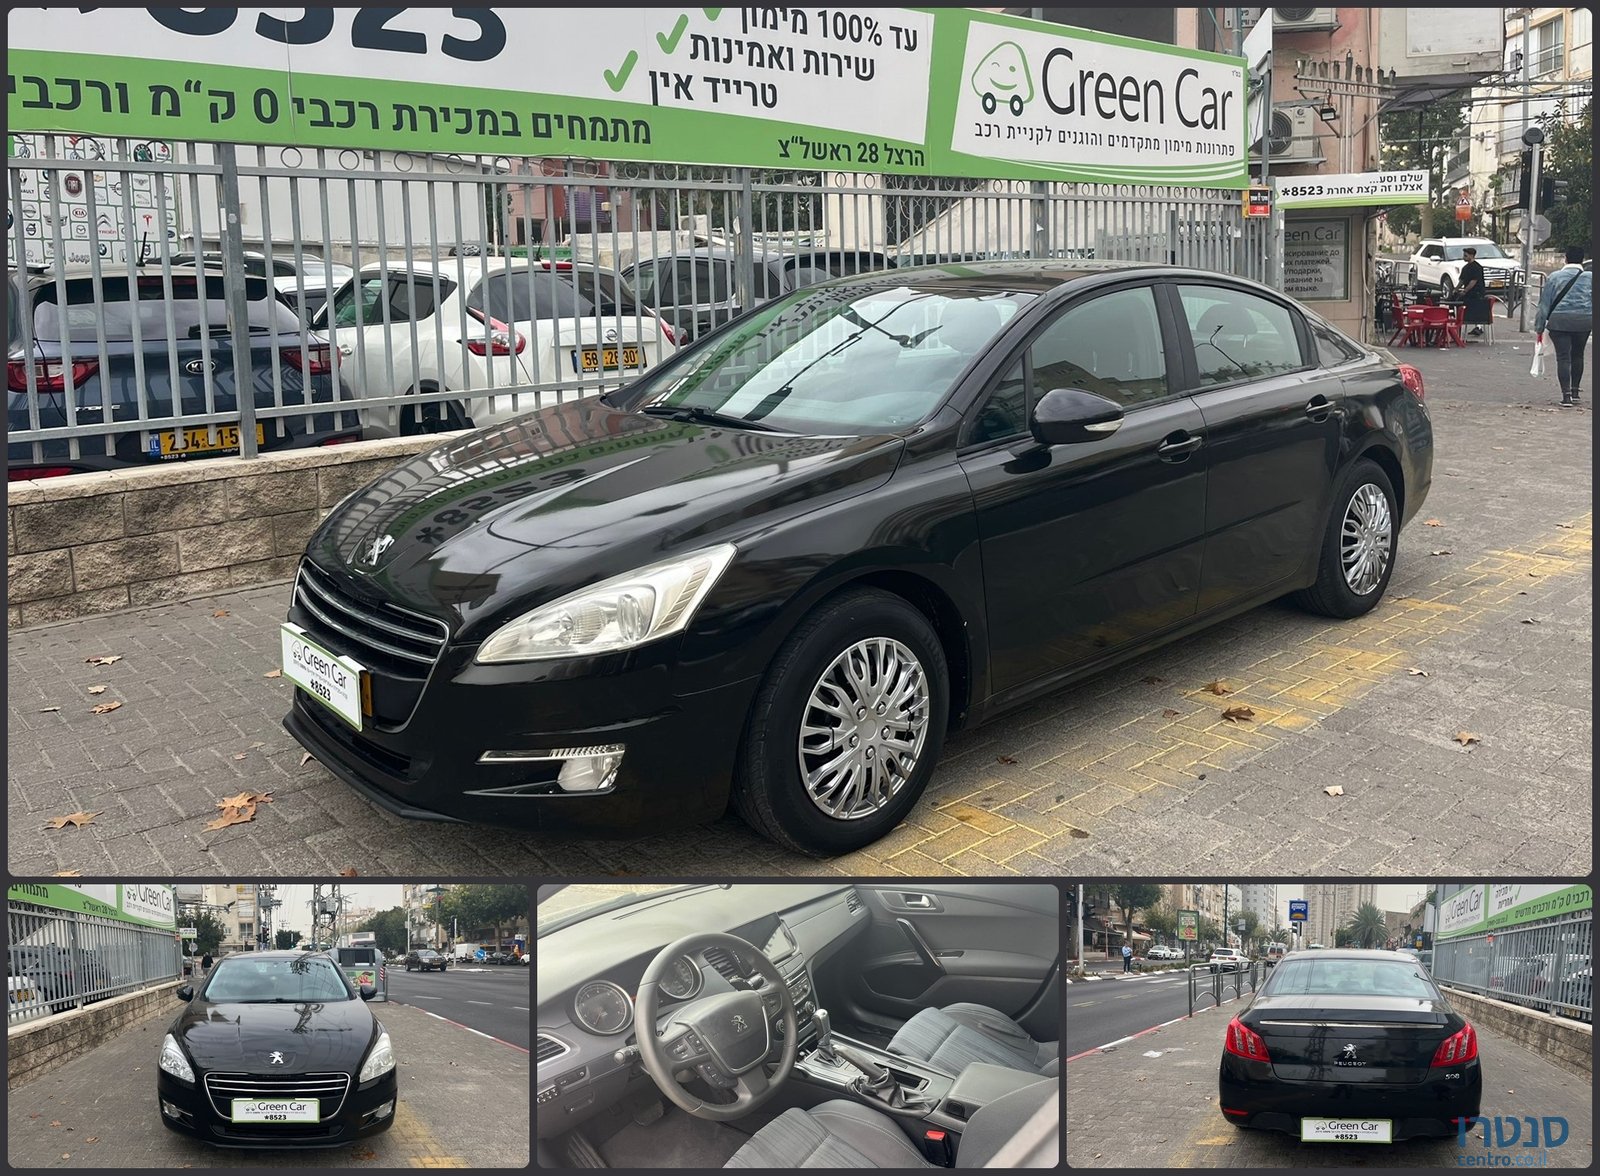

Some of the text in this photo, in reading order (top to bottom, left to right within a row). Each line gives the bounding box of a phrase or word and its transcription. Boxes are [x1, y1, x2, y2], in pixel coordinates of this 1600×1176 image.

[741, 8, 917, 51] עד 100% מימון
[690, 33, 875, 81] שירות ואמינות
[649, 69, 778, 109] טרייד אין
[1042, 47, 1233, 131] Green Car
[253, 88, 279, 124] 0
[292, 97, 380, 131] רכבי
[392, 103, 521, 137] במכירת
[532, 112, 651, 144] מתמחים
[974, 122, 1235, 156] פתרונות מימון מתקדמים והוגנים לקניית רכב
[857, 142, 879, 164] 28
[884, 144, 925, 166] הרצל
[1394, 183, 1423, 192] אצלנו
[1401, 173, 1423, 182] שלם
[1326, 186, 1354, 195] אחרת
[1356, 186, 1378, 195] קצת
[1380, 185, 1392, 193] זה
[1314, 227, 1341, 240] Car
[303, 645, 347, 690] Green Car
[162, 890, 172, 911] Car
[1451, 889, 1483, 919] Green Car
[1445, 1072, 1460, 1080] 508
[258, 1101, 306, 1111] Green Car
[1328, 1121, 1379, 1131] Green Car
